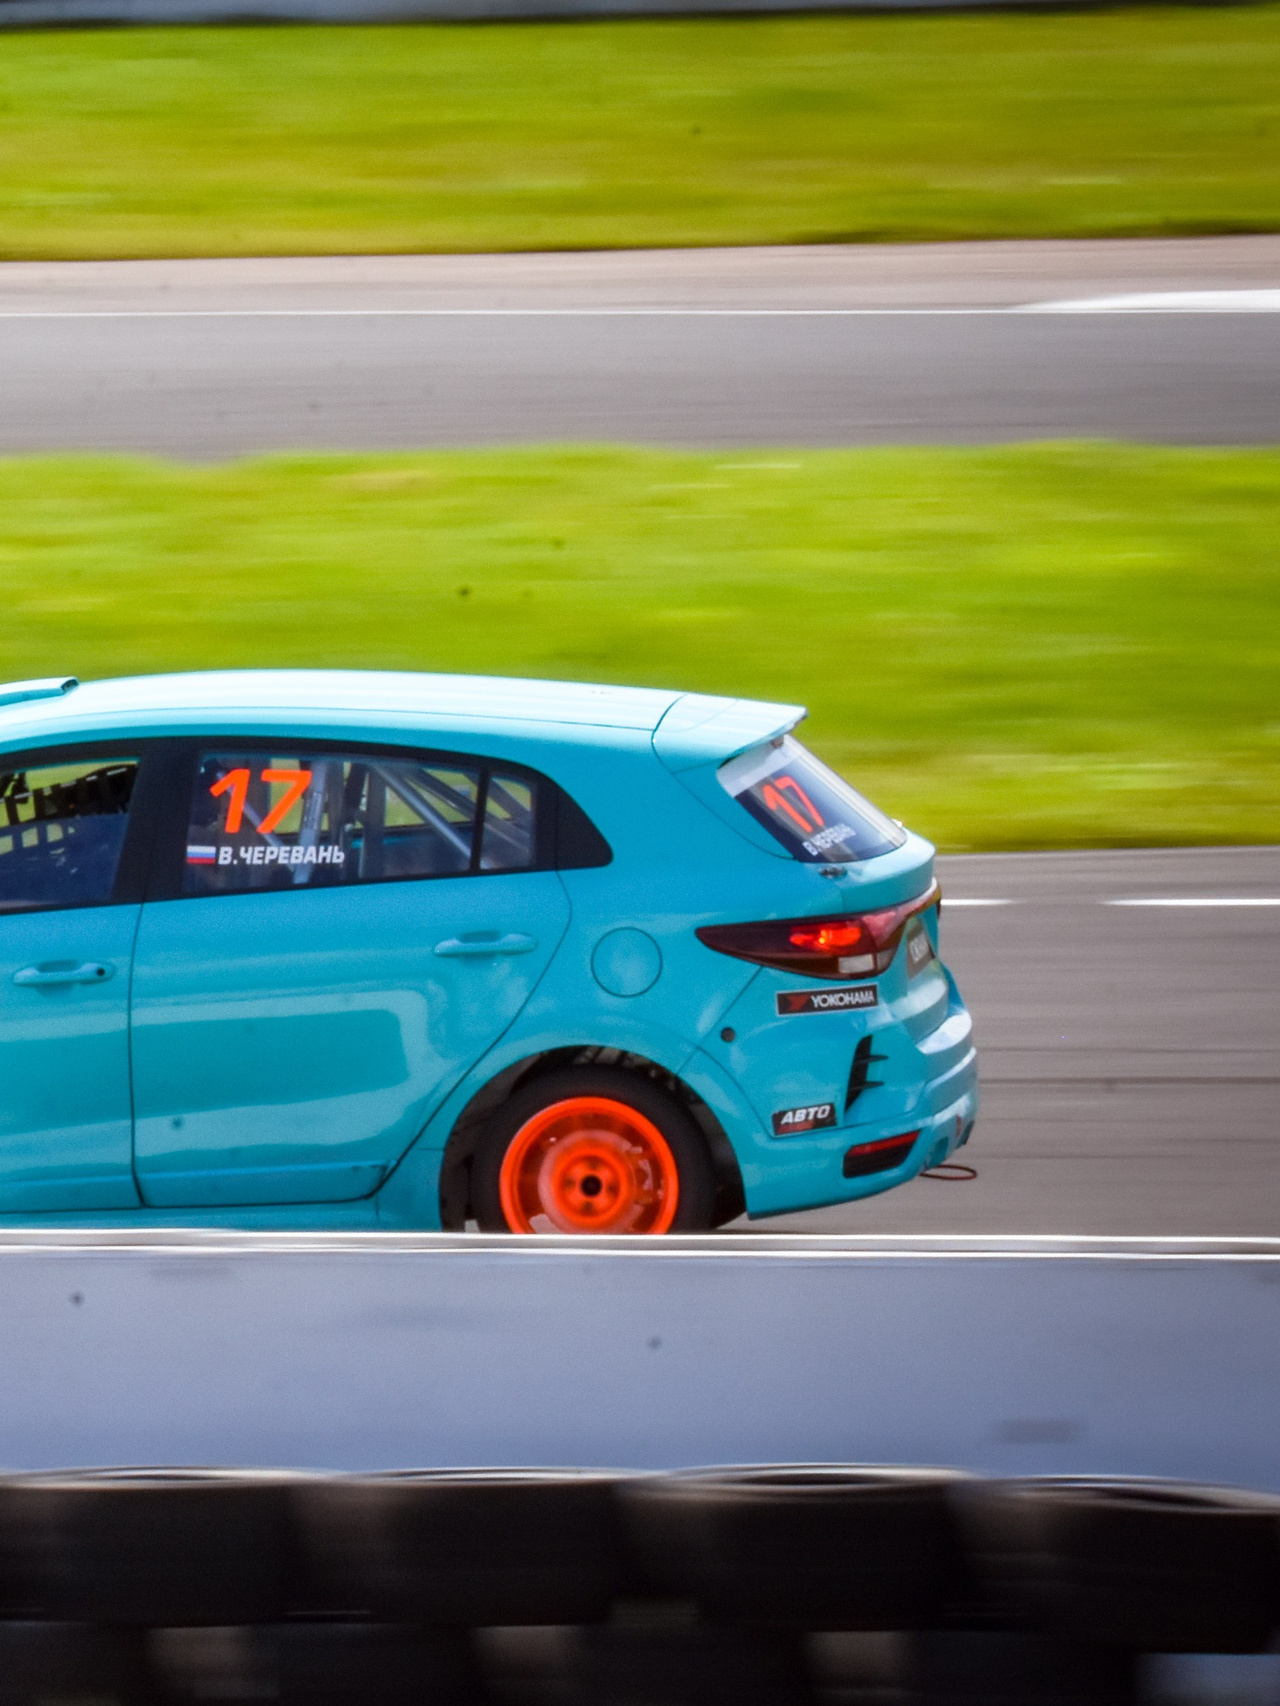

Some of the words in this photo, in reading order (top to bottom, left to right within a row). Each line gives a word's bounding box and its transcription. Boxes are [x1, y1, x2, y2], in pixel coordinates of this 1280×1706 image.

[209, 768, 313, 834] 17
[761, 774, 825, 834] 17
[218, 845, 345, 865] В.ЧЕРЕВАНЬ
[810, 989, 875, 1008] YOKOHAMA
[780, 1104, 831, 1125] АВТО
